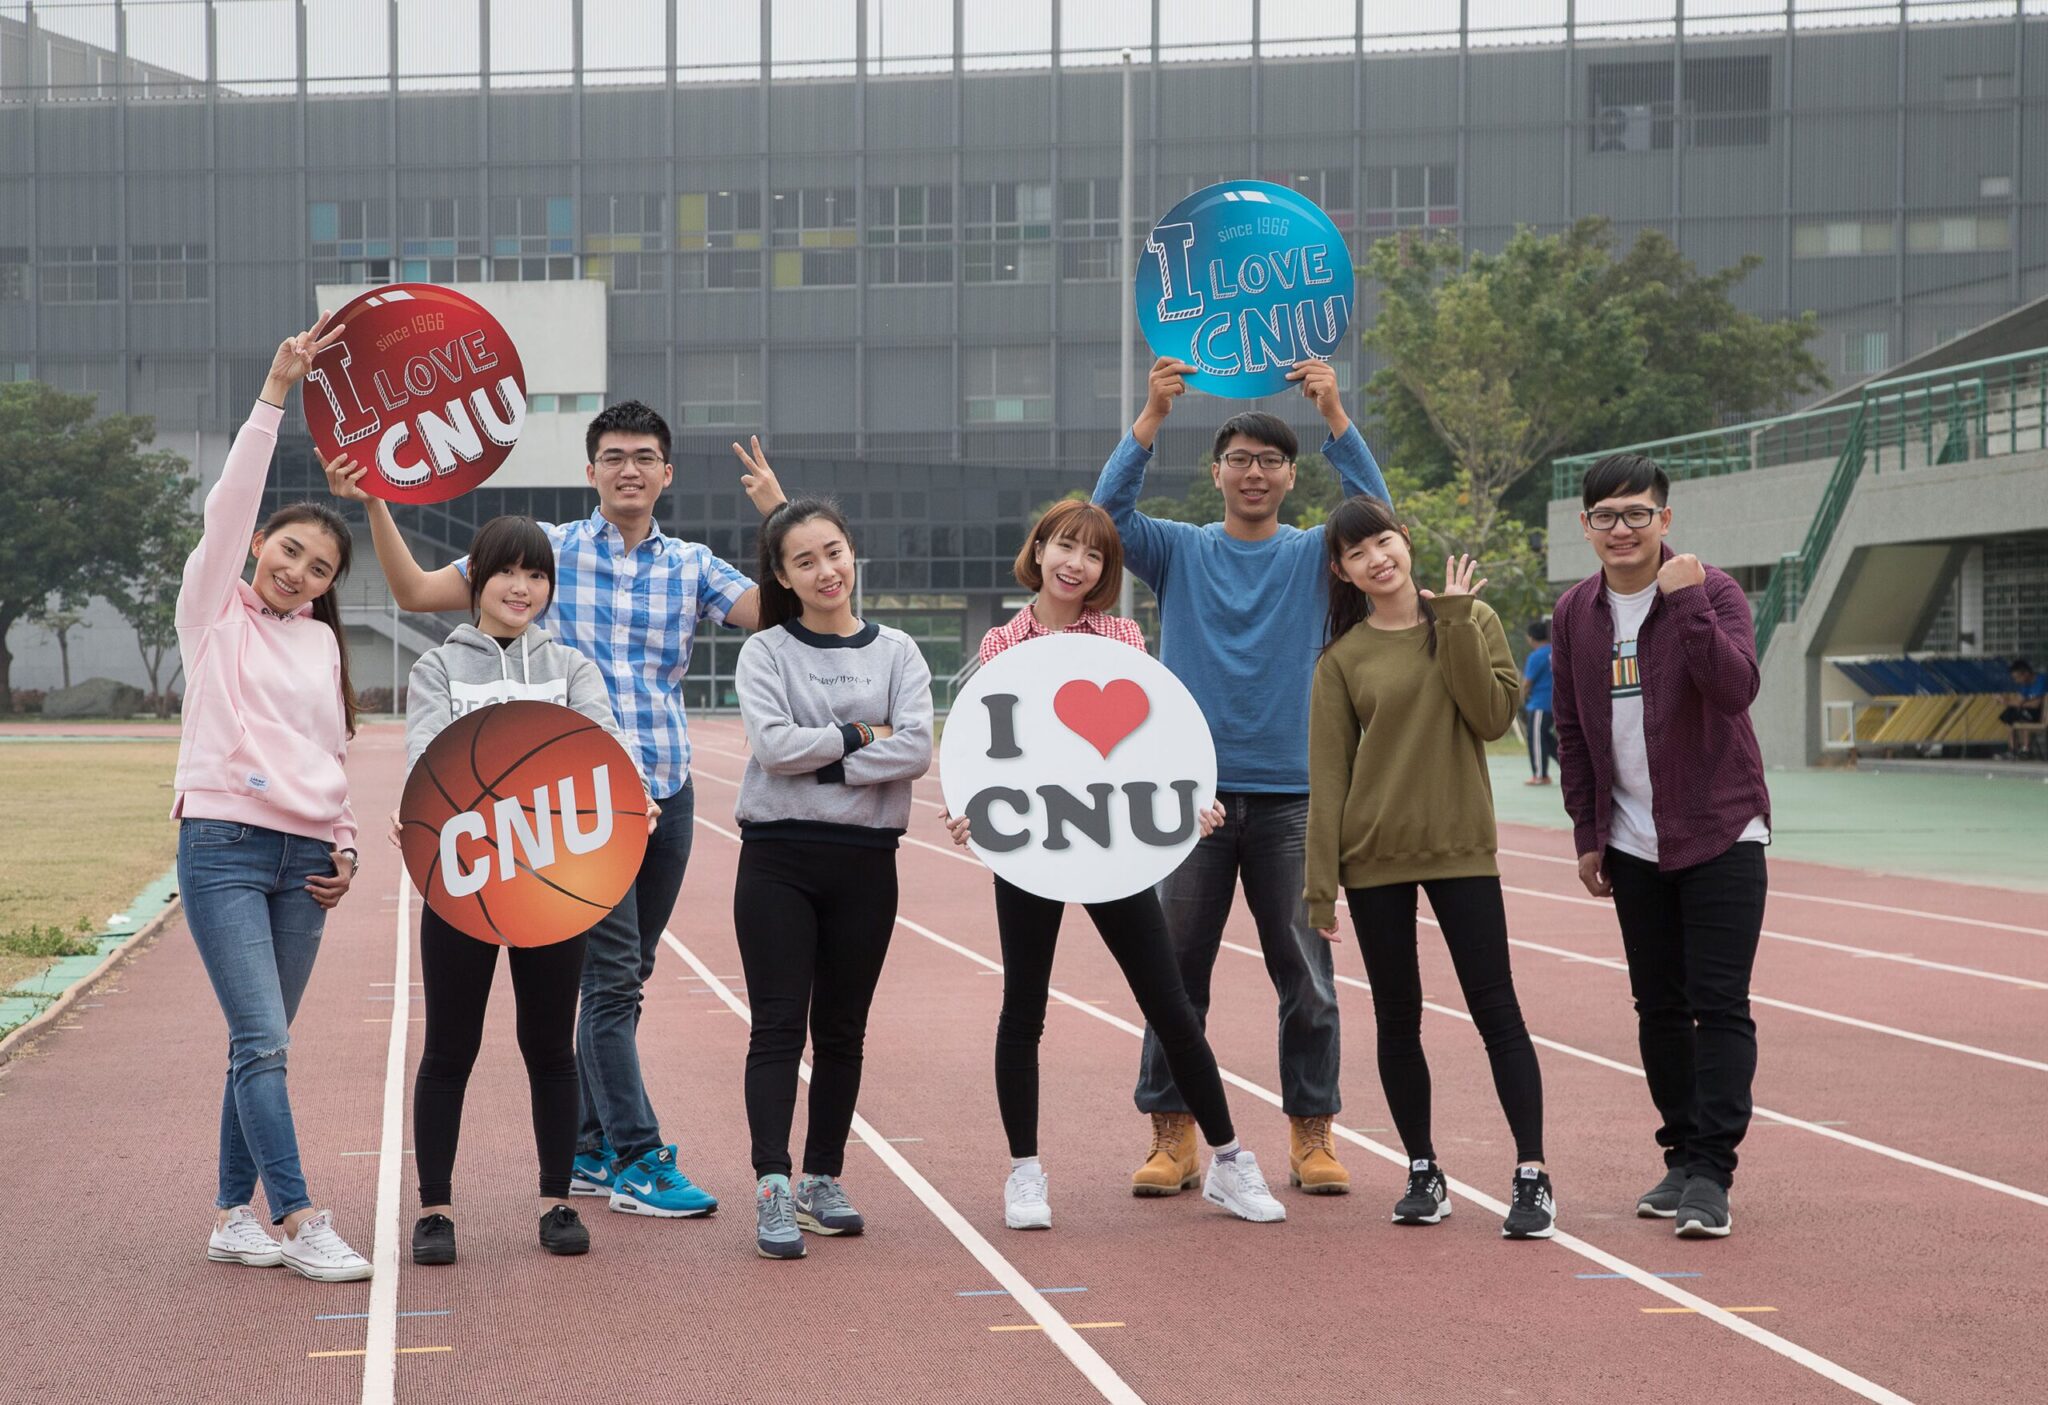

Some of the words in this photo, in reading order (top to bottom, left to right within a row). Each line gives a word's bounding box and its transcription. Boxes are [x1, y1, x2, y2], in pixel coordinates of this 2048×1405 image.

[1217, 224, 1253, 243] since
[1257, 216, 1290, 237] 1966
[1146, 222, 1204, 322] I
[1209, 244, 1333, 300] LOVE
[376, 324, 410, 352] since
[411, 312, 445, 334] 1966
[1191, 295, 1350, 376] CNU
[307, 341, 381, 448] I
[373, 329, 498, 411] LOVE
[375, 375, 527, 487] CNU
[980, 693, 1023, 759] I
[439, 764, 614, 898] CNU
[964, 779, 1198, 853] CNU
